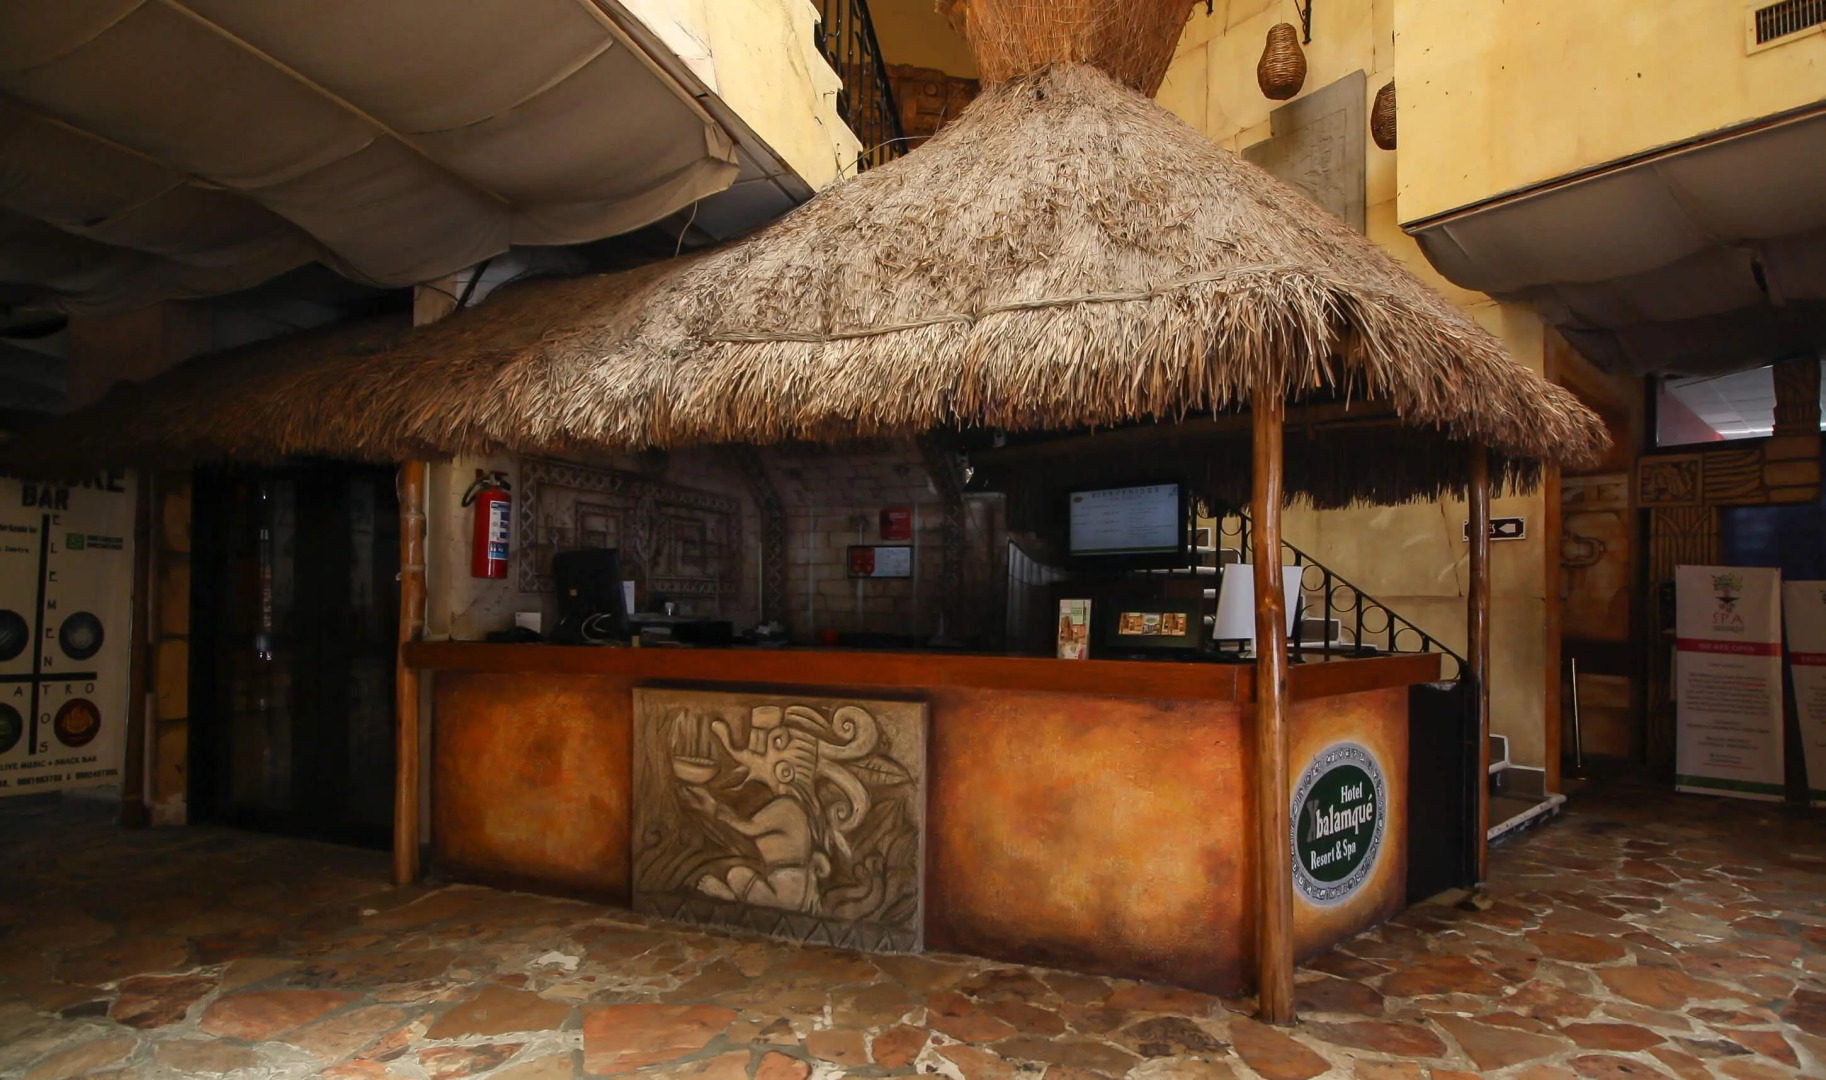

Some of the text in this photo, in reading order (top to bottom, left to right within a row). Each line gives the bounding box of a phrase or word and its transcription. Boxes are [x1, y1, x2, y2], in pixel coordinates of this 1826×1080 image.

[22, 485, 69, 511] BAR
[1711, 612, 1744, 625] SPA
[1340, 781, 1363, 804] Hotel
[1310, 838, 1357, 870] Resort & Spa
